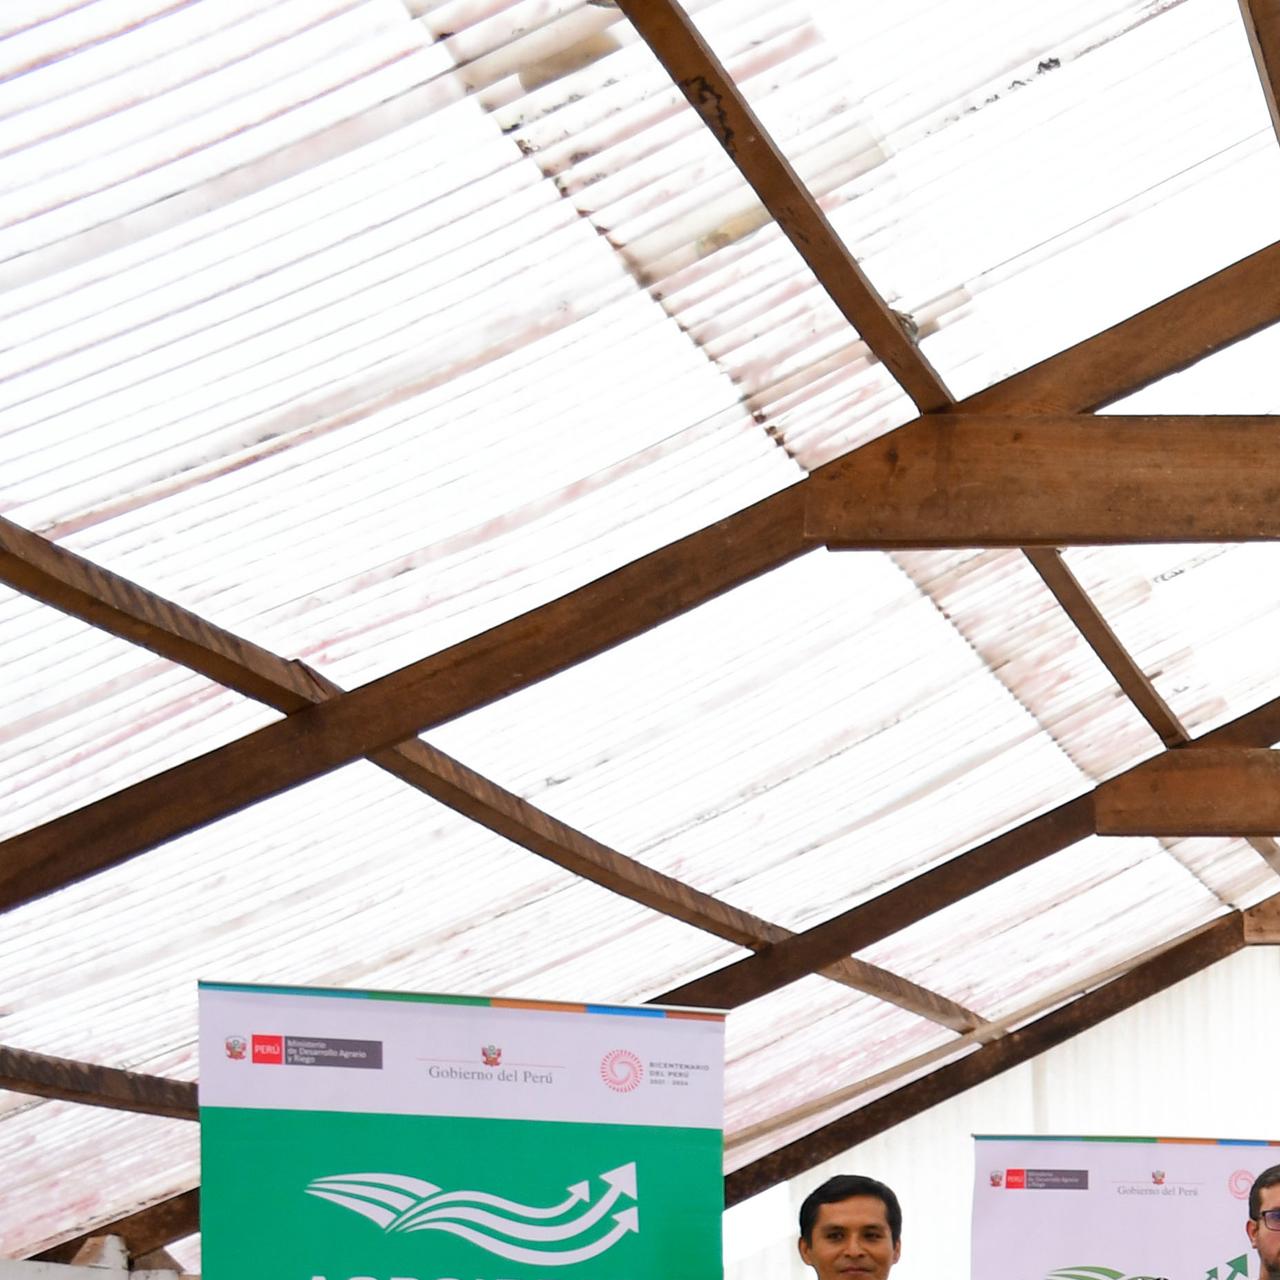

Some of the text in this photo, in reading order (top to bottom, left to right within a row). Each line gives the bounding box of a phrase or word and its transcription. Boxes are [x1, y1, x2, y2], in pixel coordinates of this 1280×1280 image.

[254, 1043, 280, 1055] PERÚ
[649, 1061, 710, 1072] BICENTENARIO
[428, 1064, 553, 1085] Gobierno del Perú
[667, 1069, 690, 1079] PERÚ
[1116, 1186, 1164, 1197] Gobierno
